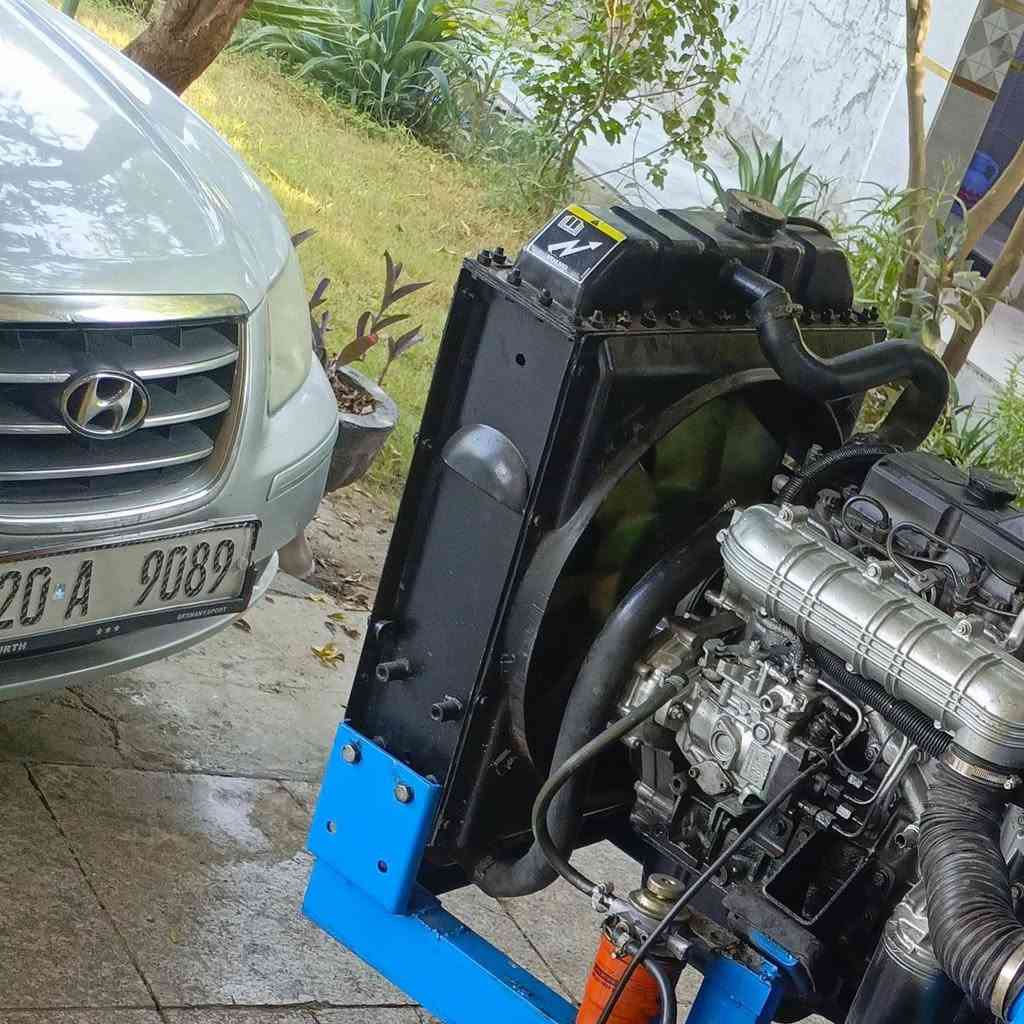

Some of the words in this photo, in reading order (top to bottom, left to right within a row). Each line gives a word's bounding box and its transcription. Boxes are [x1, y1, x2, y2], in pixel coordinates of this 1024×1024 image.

[0, 566, 51, 629] 20
[65, 560, 93, 619] A
[136, 539, 235, 607] 9089
